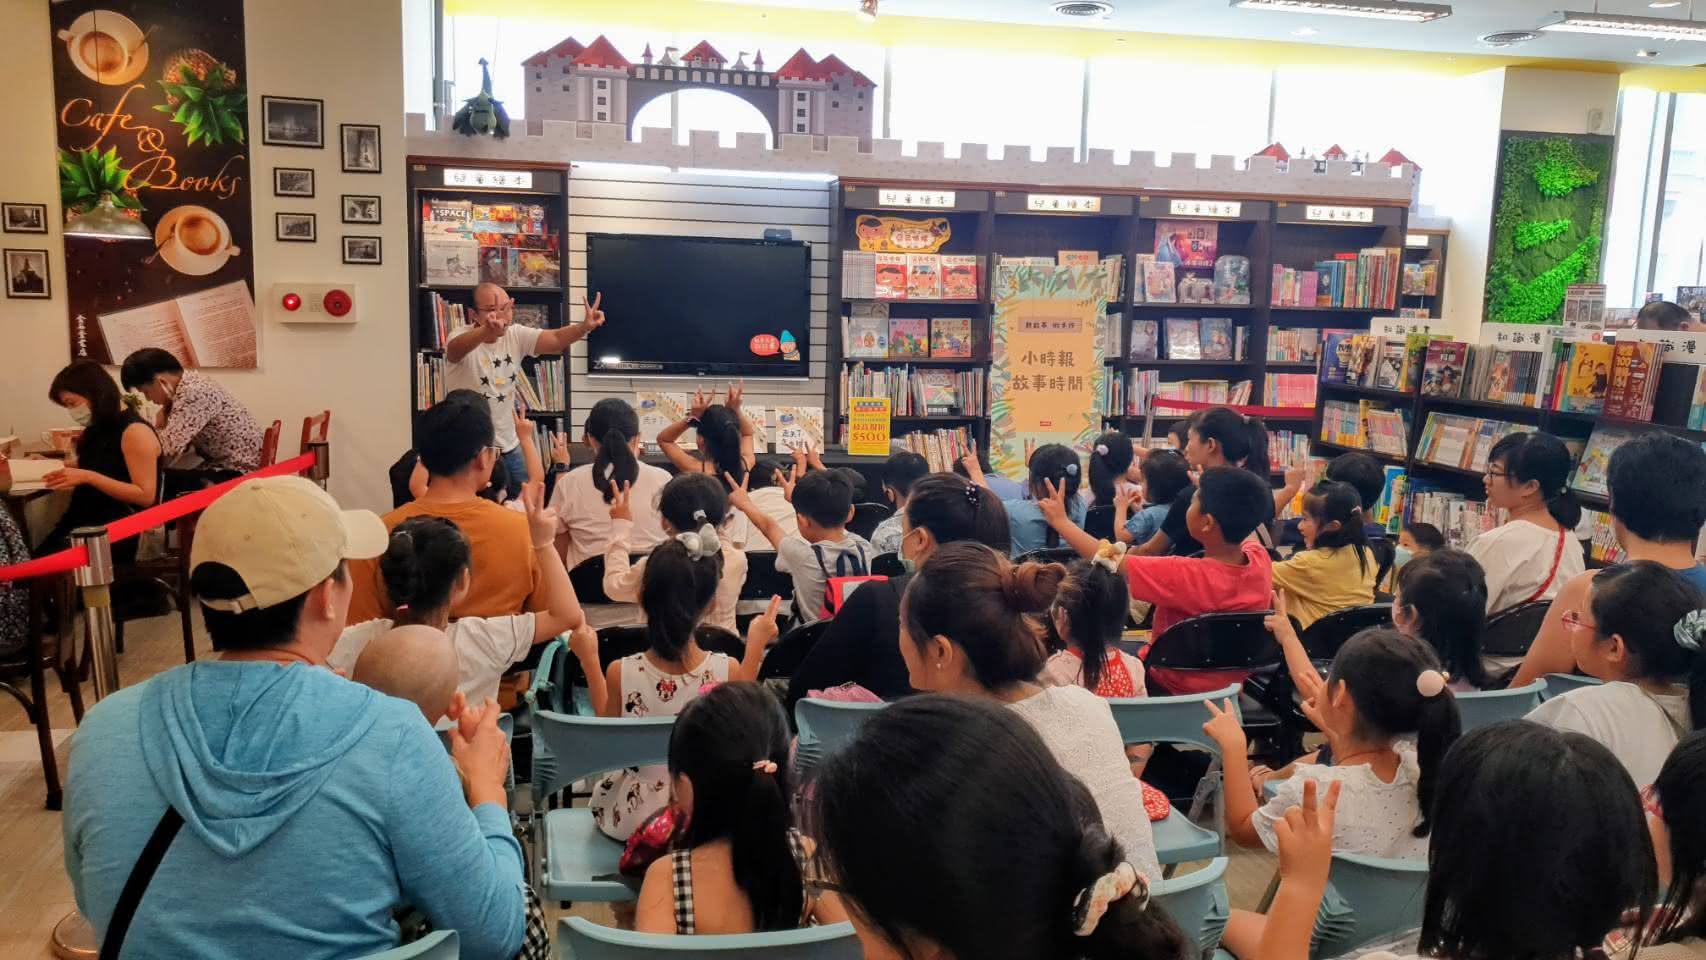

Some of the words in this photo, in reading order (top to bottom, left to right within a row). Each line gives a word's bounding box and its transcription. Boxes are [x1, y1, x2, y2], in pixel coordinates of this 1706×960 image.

[123, 155, 245, 199] Books
[1021, 351, 1074, 367] 小時報
[1012, 374, 1083, 392] 故事時間
[853, 432, 886, 441] $500
